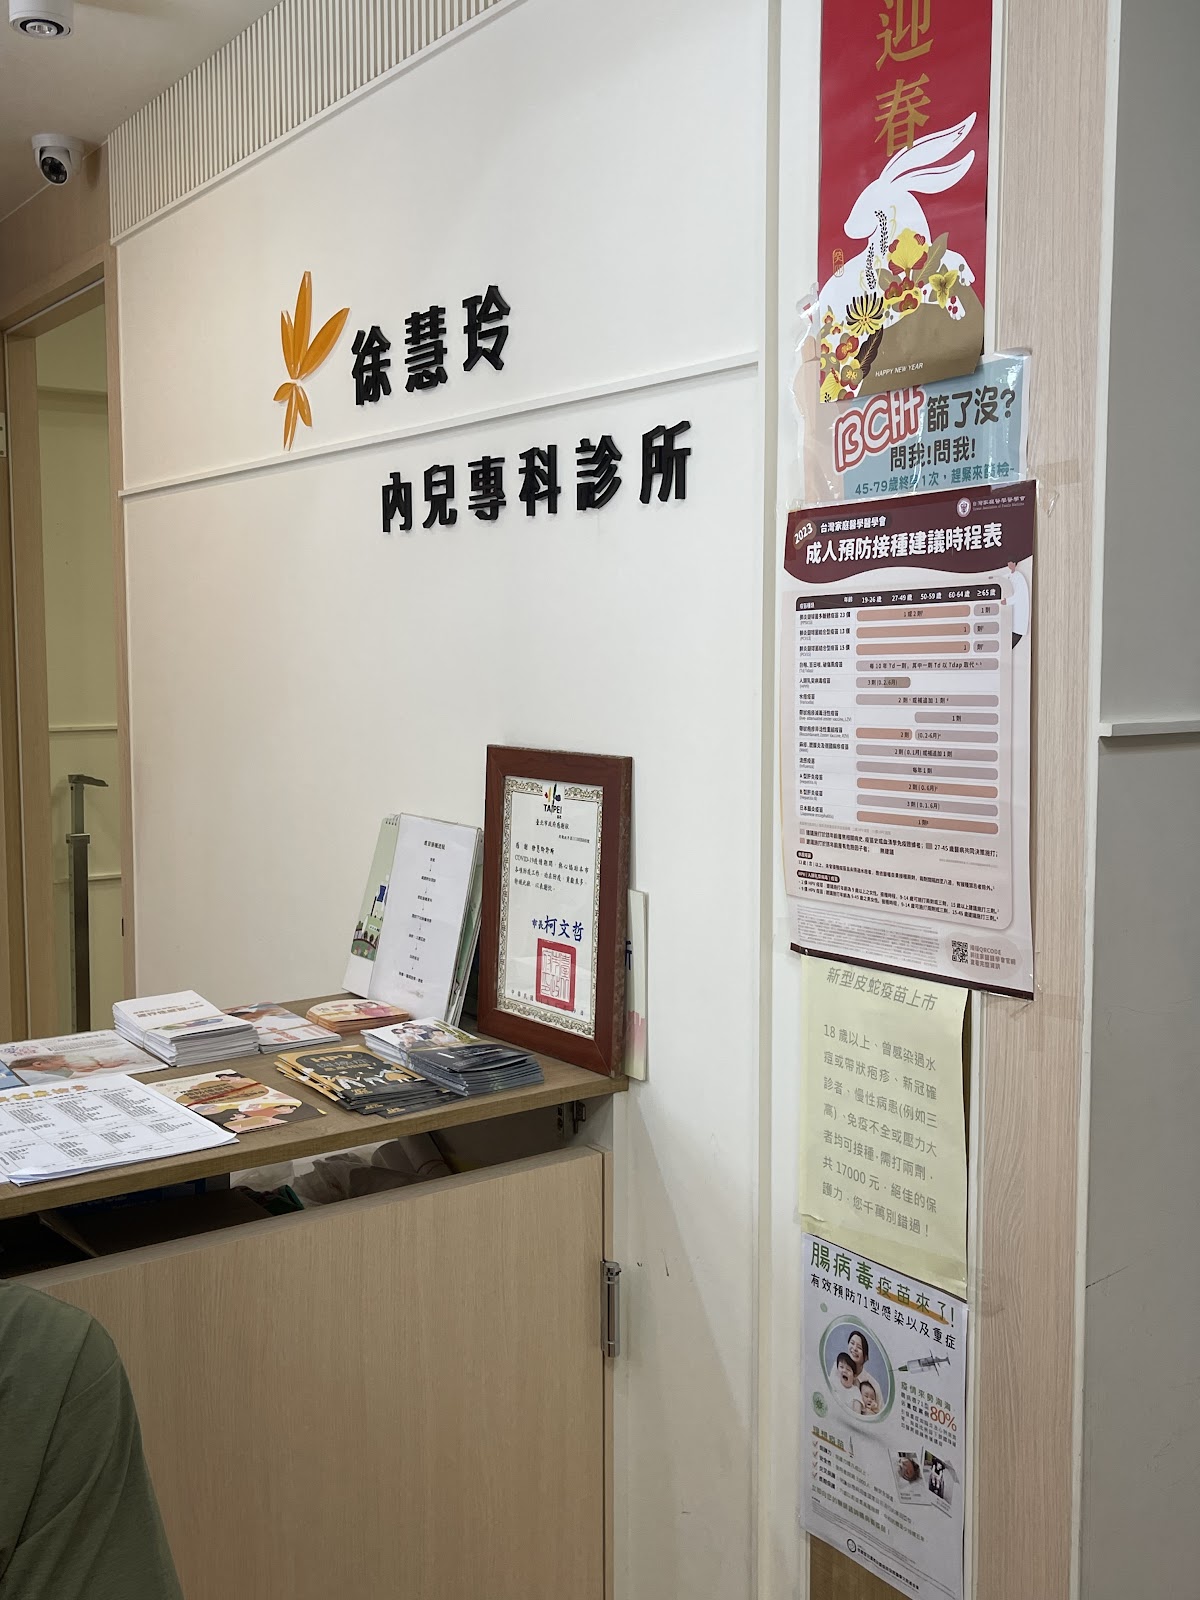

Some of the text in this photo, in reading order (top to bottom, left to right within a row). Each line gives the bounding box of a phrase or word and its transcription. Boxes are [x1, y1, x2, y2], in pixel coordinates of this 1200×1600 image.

[351, 284, 511, 405] 徐慧玲
[875, 362, 924, 377] HAPPY NEW YEAR
[381, 420, 692, 533] 內兒專科診所
[794, 523, 813, 544] 2023
[820, 516, 887, 534] 台灣家庭醫學醫學會
[806, 523, 1002, 564] 成人預防接種建議時程表
[544, 804, 562, 814] TAIPEI
[826, 966, 938, 1011] 新型皮蛇疫苗上市
[824, 1024, 836, 1038] 18
[310, 1054, 353, 1062] HPV
[823, 1156, 833, 1171] 共
[836, 1162, 866, 1184] 17000
[811, 1242, 955, 1328] 腸病毒疫苗來了!
[811, 1273, 956, 1350] 有效預防71型感染以及重症
[930, 1406, 956, 1431] 80%
